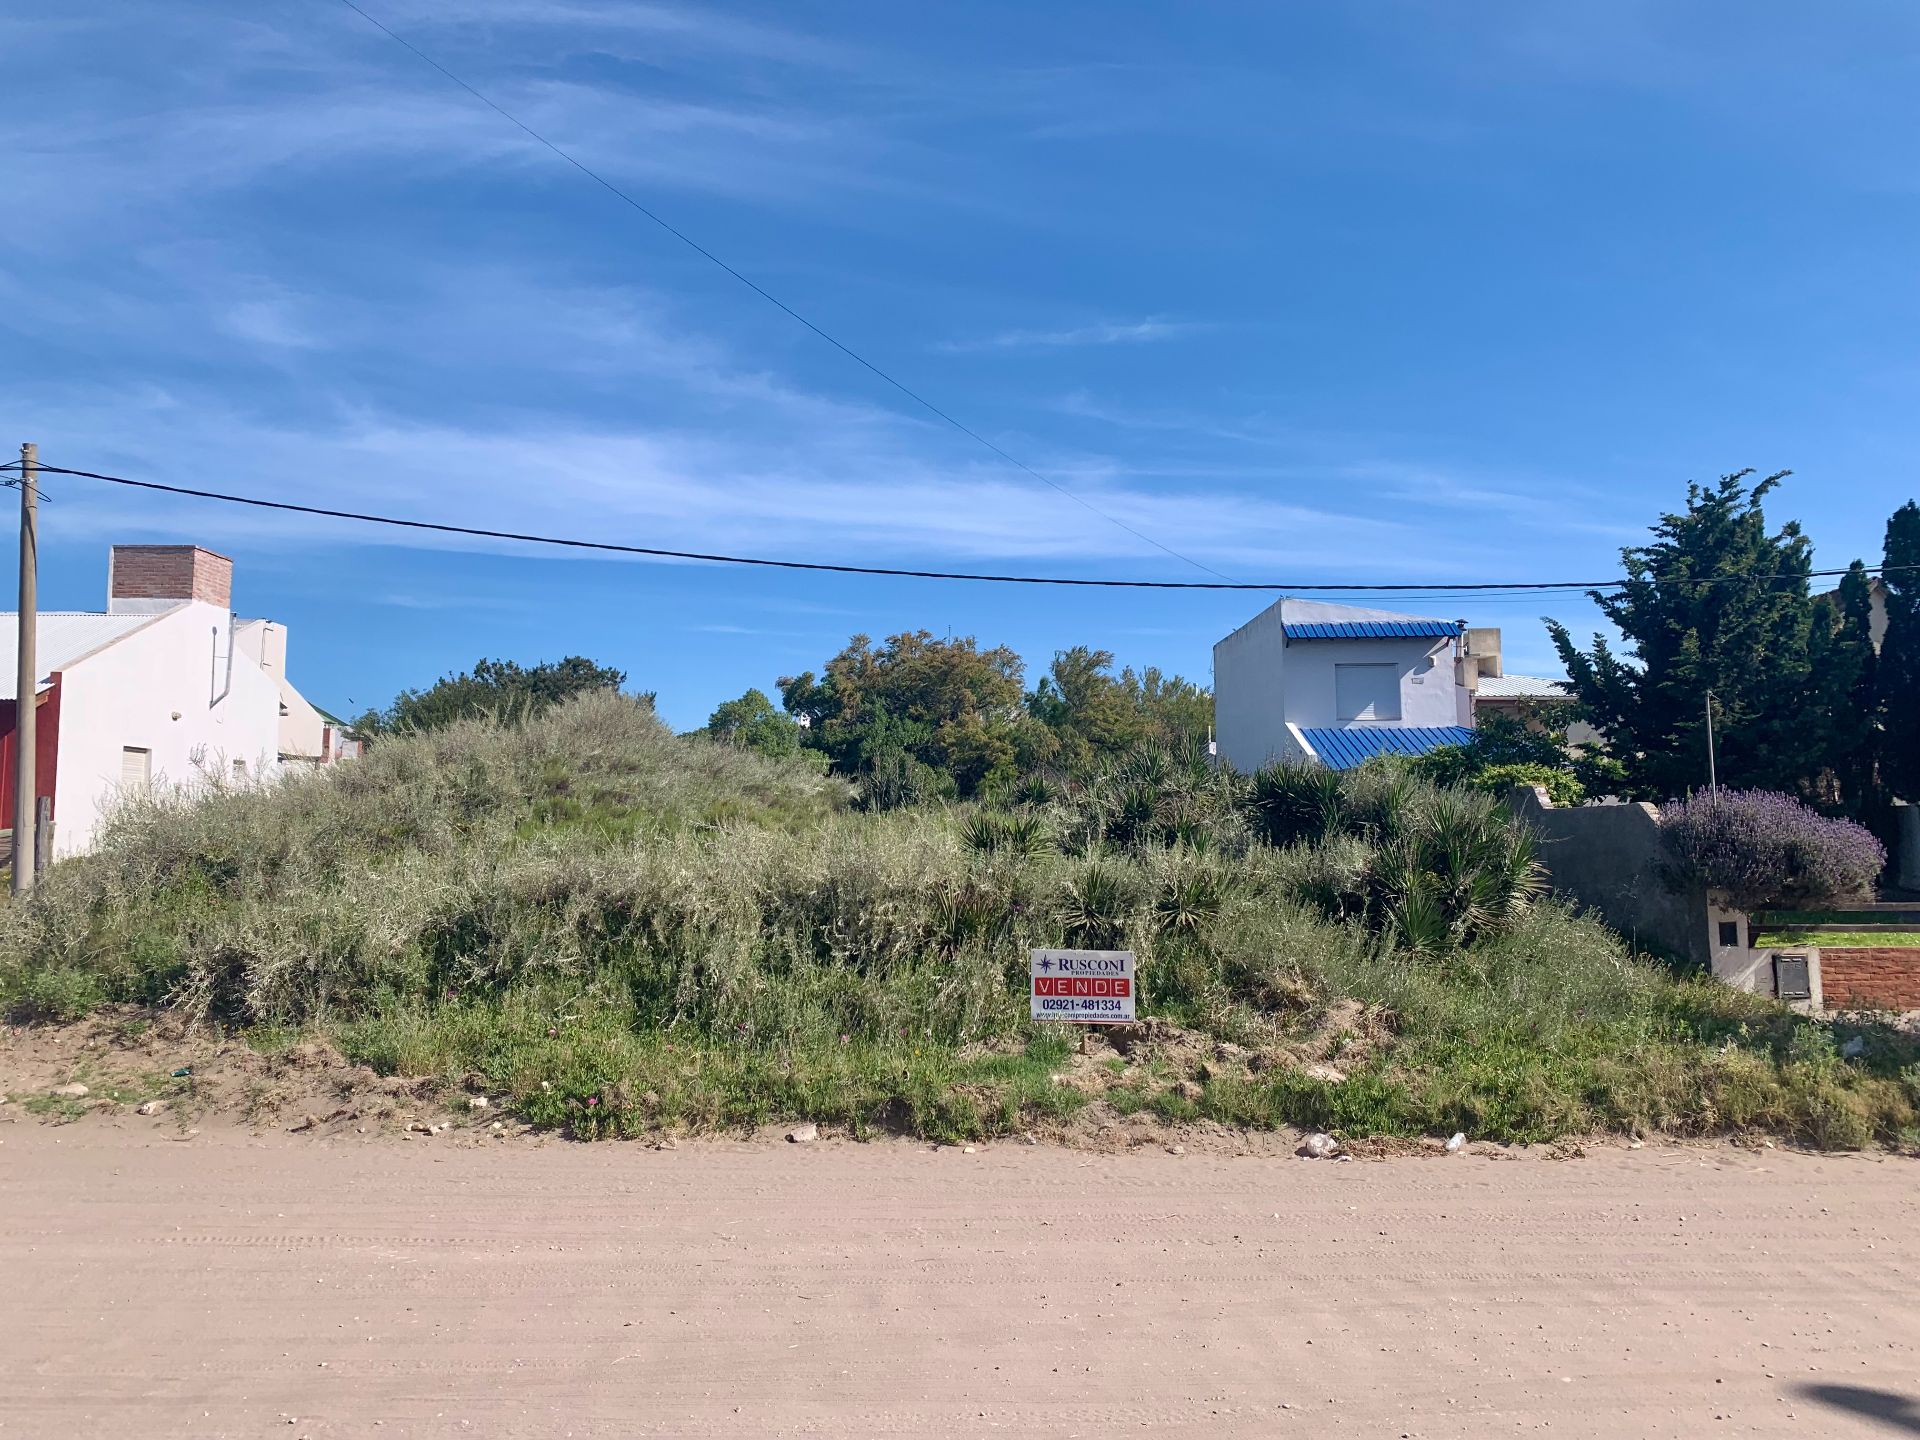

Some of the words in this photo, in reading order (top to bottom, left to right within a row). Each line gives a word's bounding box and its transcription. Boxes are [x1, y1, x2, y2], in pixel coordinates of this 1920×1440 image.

[1058, 958, 1125, 972] RUSCONI
[1039, 980, 1125, 995] VENDE
[1042, 999, 1121, 1011] 02921-481334
